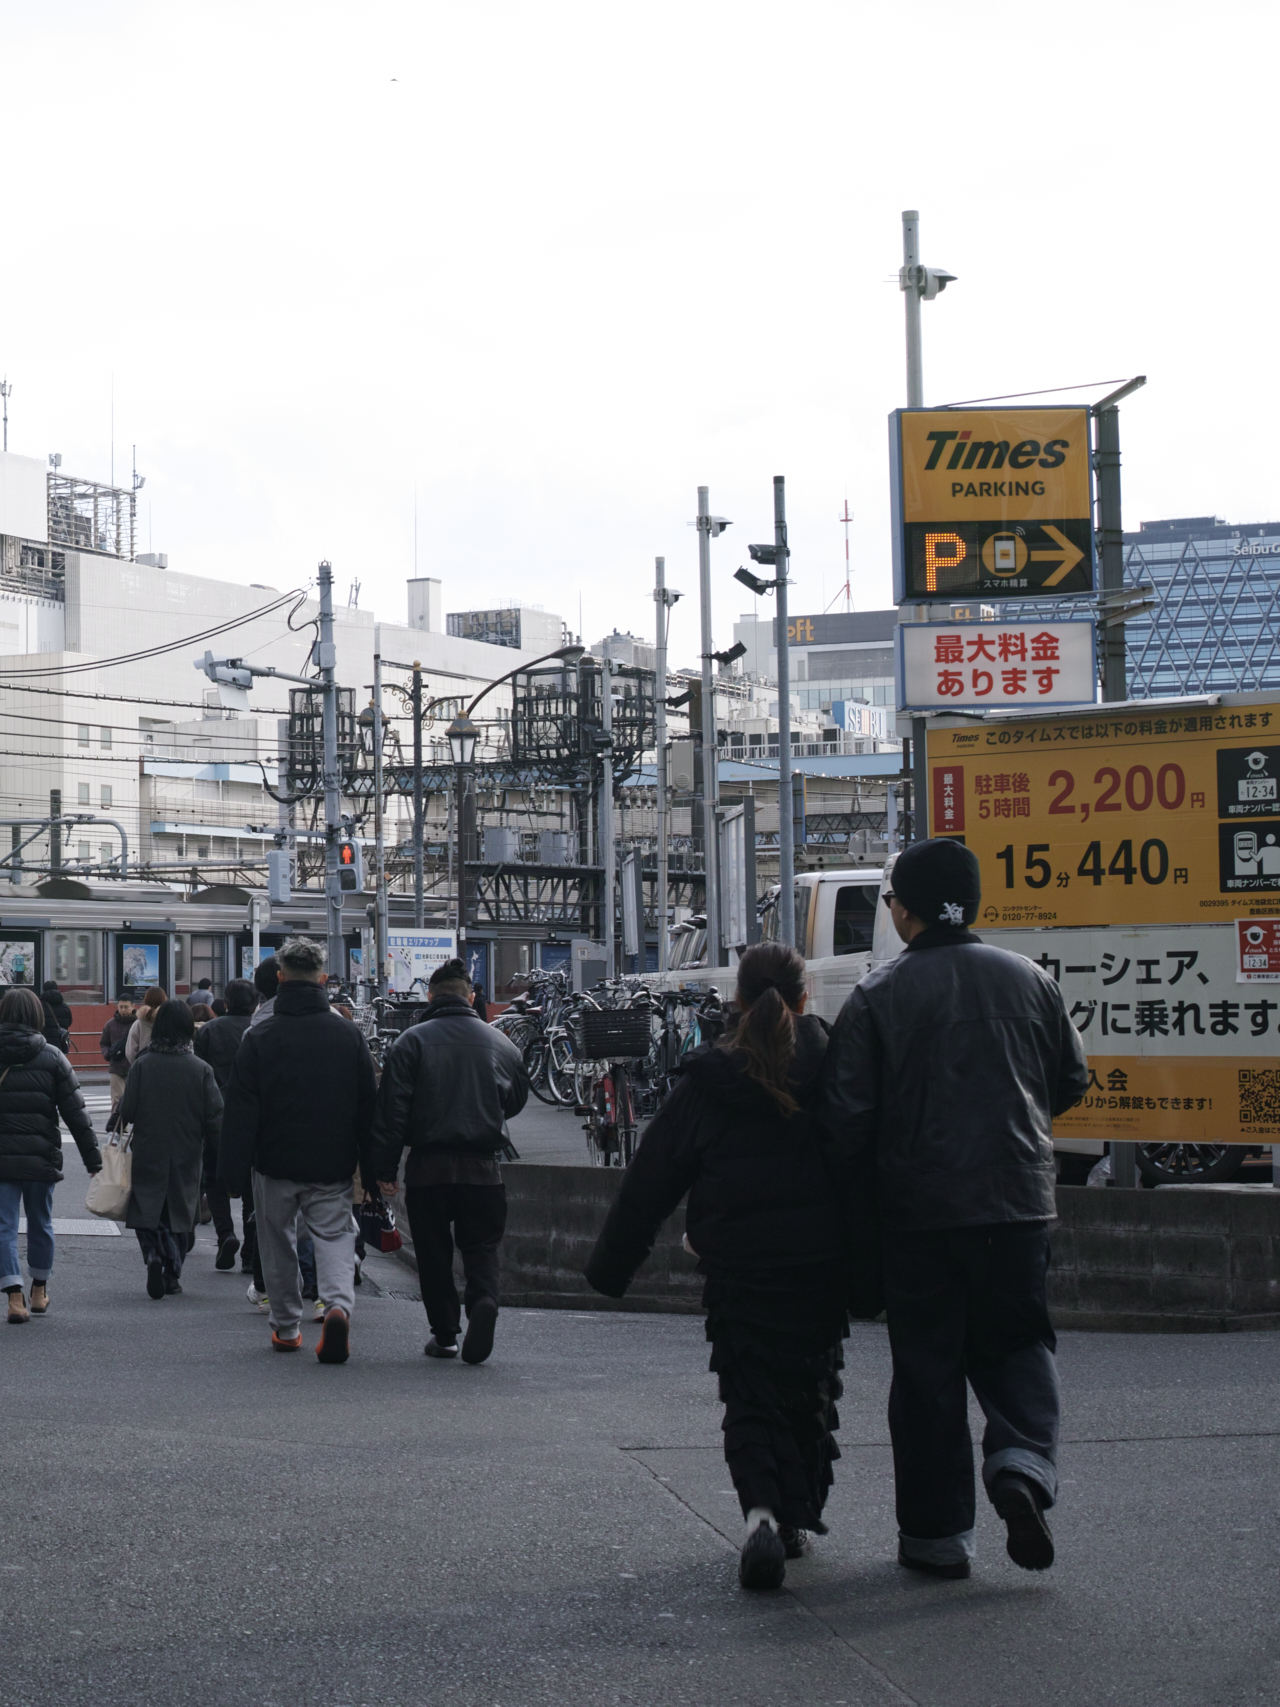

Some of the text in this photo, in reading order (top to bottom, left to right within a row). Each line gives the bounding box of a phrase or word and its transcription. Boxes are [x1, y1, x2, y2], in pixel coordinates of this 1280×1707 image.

[924, 430, 1070, 470] Times
[951, 481, 1046, 498] PARKING
[1233, 541, 1270, 556] Seibu
[925, 533, 966, 591] P
[983, 578, 1028, 588] スマホ精算
[934, 631, 1060, 664] 最大料金
[936, 666, 1060, 697] あります
[985, 711, 1273, 745] このタイムズでは以下の料金が適用されます
[952, 733, 980, 743] Times
[974, 772, 1030, 795] 駐車後
[1246, 785, 1274, 798] 12-34
[943, 773, 954, 819] 最大料金
[979, 797, 1030, 819] 5時間
[1231, 898, 1280, 906] タイムズ池袋北口
[1002, 912, 1057, 921] 0120-77-8924
[1073, 1096, 1213, 1110] リから解錠もできます!
